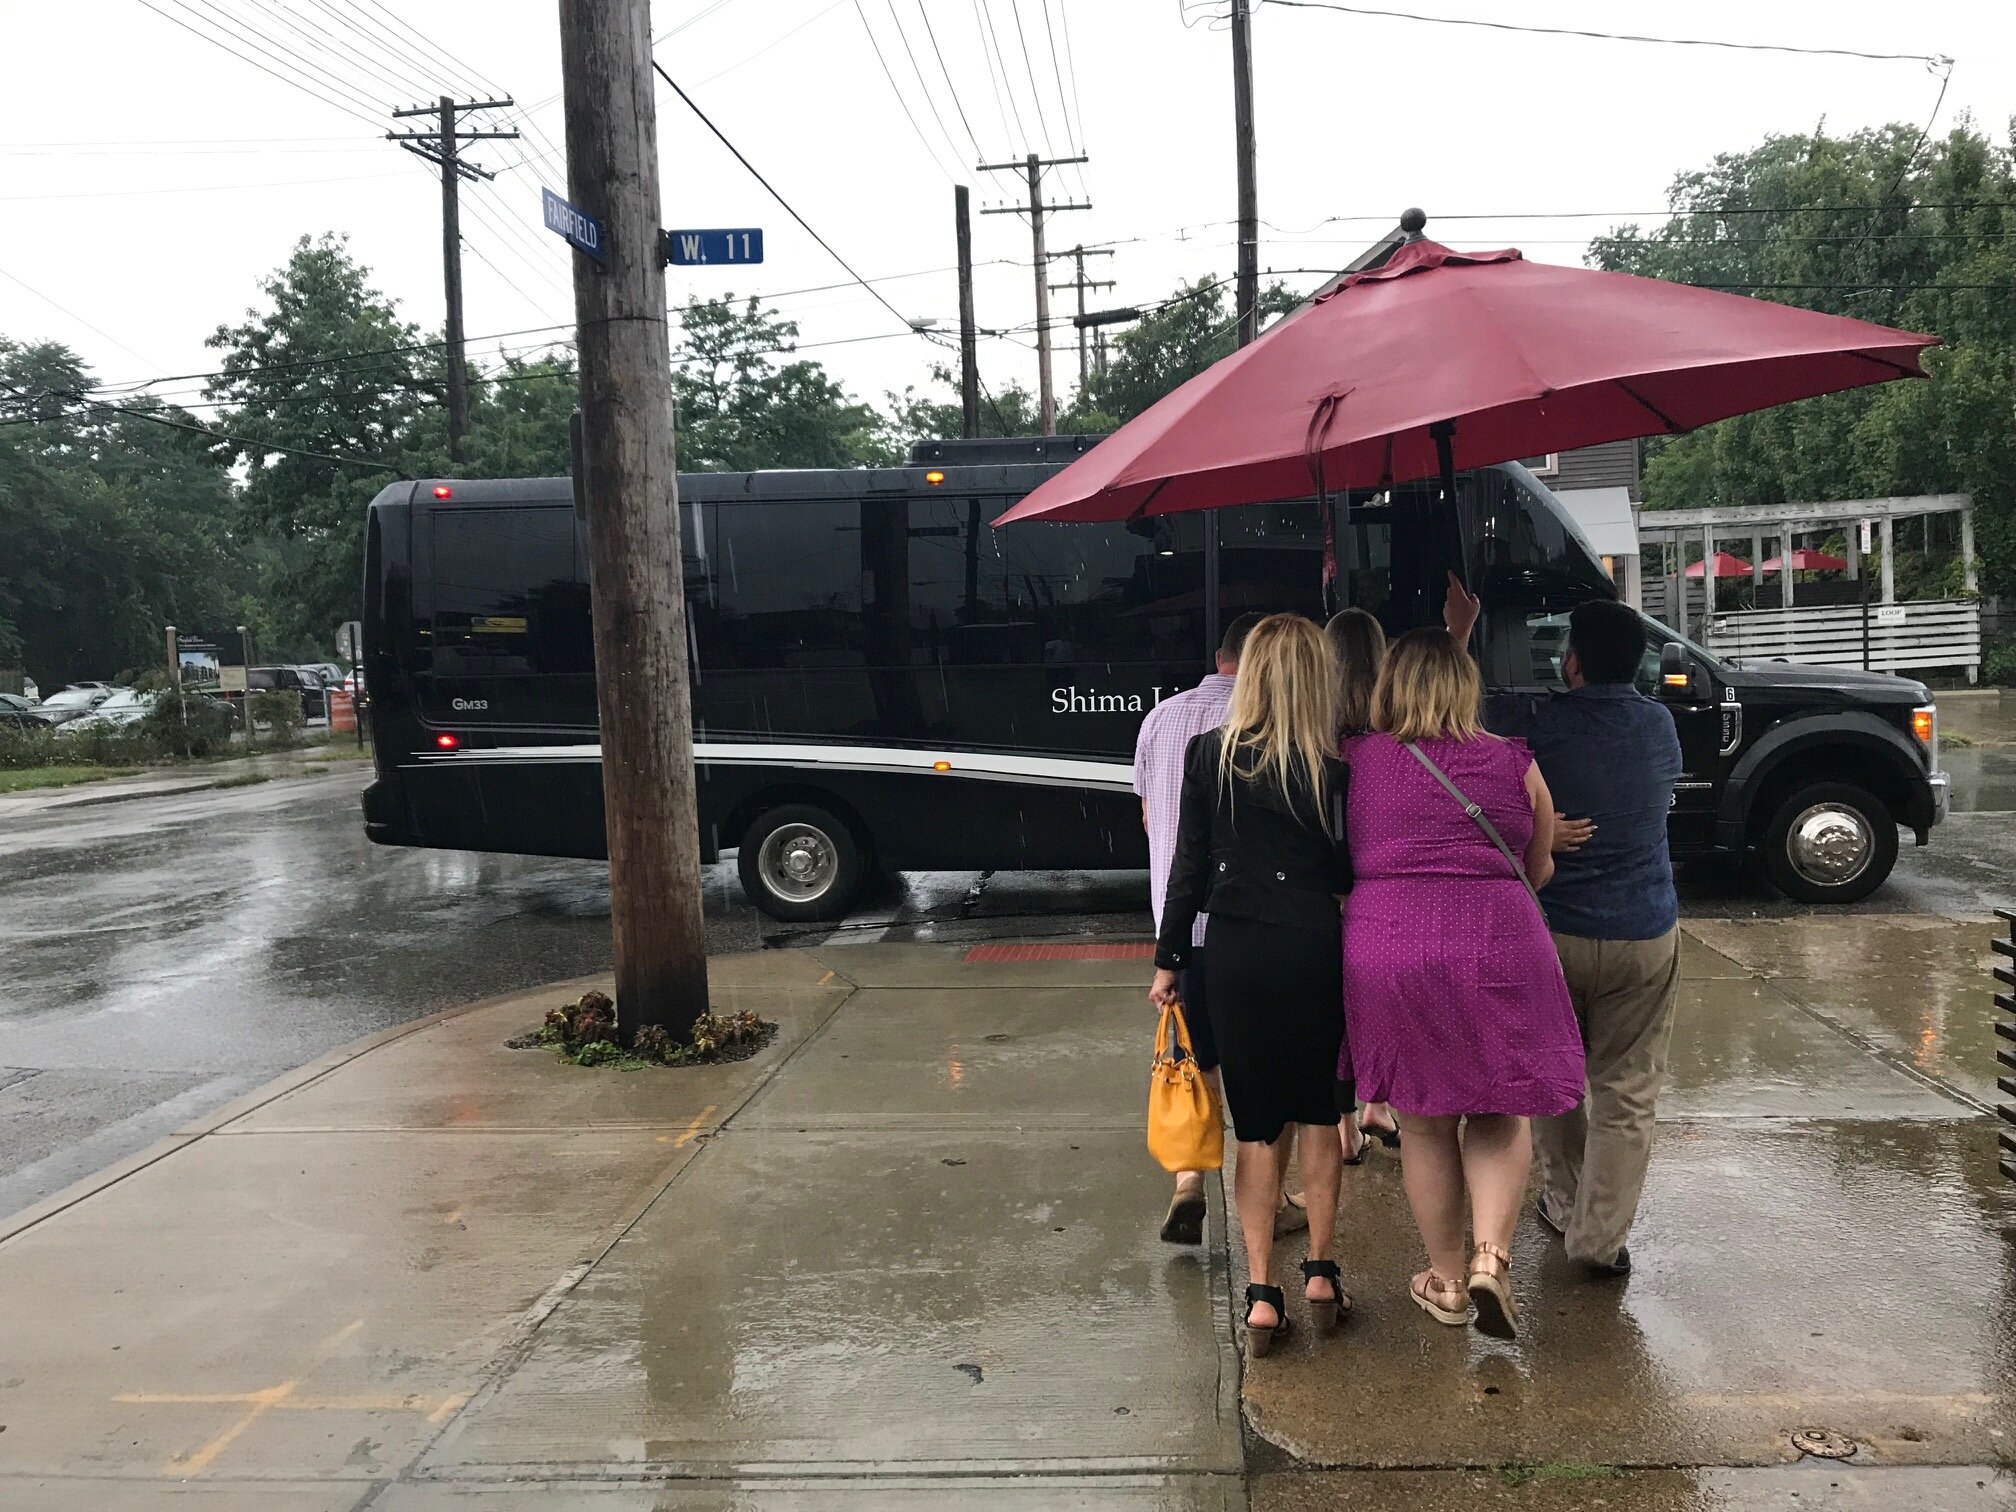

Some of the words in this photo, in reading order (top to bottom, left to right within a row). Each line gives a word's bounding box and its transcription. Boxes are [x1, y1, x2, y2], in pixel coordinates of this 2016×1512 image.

[547, 195, 598, 249] FAIRFIELD
[726, 233, 750, 260] 11
[1051, 686, 1143, 713] Shima
[1727, 688, 1733, 700] 6
